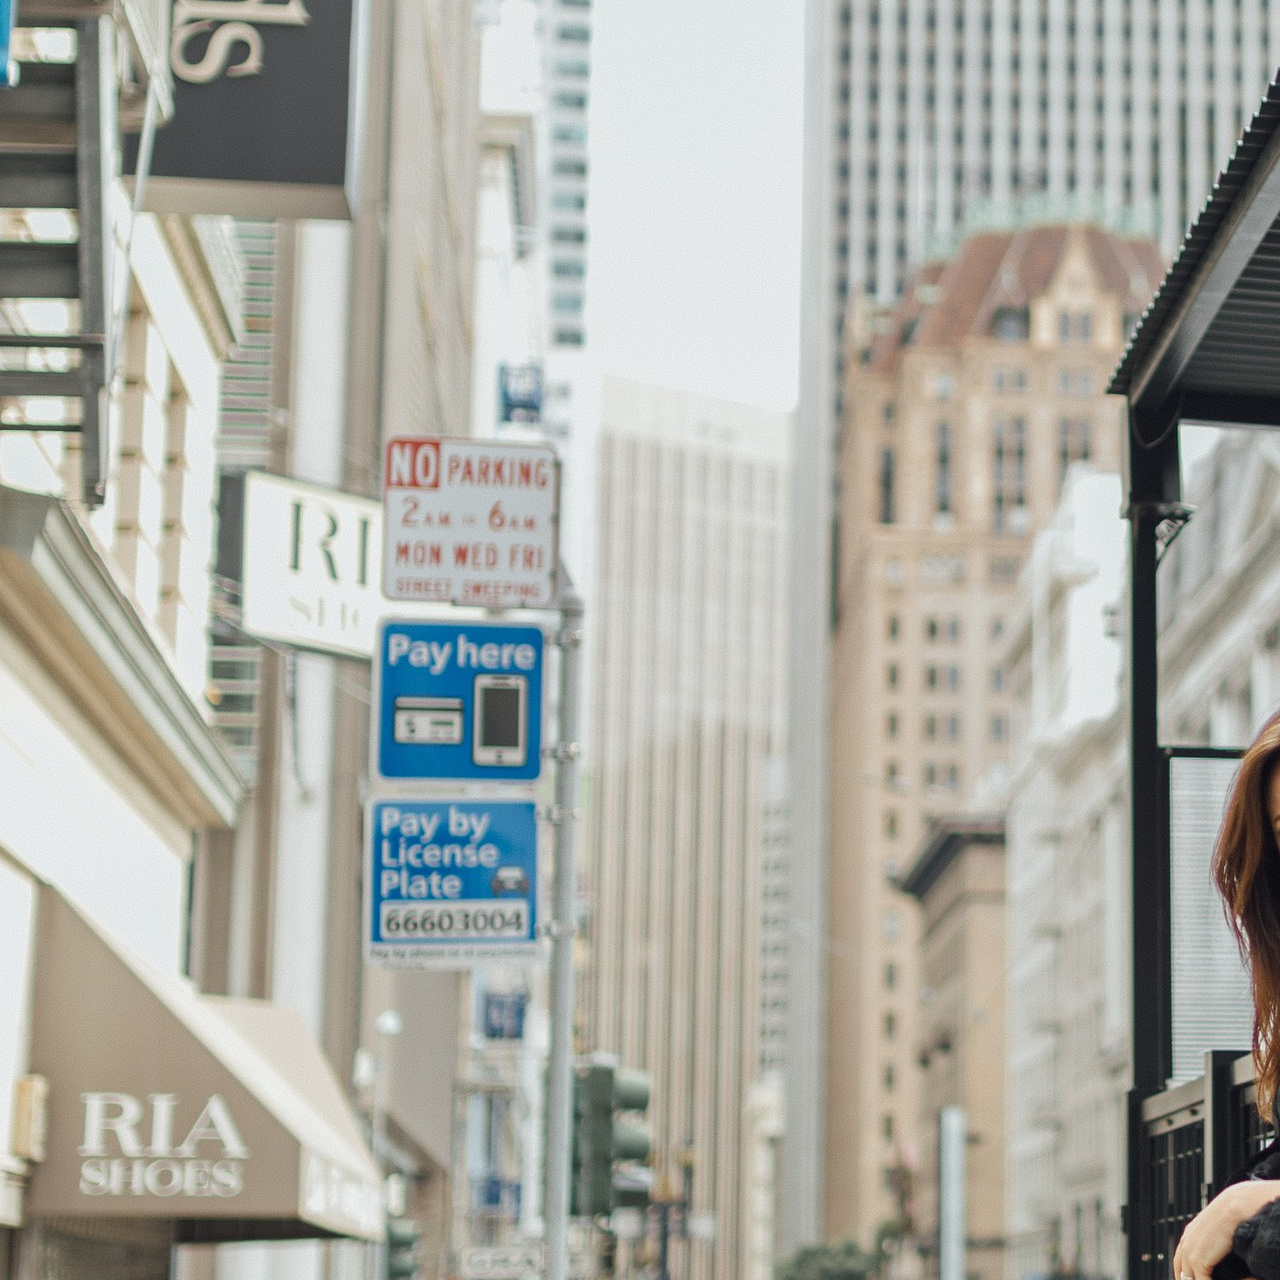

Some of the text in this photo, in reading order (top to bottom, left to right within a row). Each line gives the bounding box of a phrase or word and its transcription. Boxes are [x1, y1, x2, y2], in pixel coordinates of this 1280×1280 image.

[390, 443, 548, 490] NO PARKING
[288, 497, 370, 588] RI
[396, 540, 544, 572] MON WED FRI
[395, 577, 452, 595] STREET
[387, 632, 537, 676] Pay here
[380, 804, 491, 844] Pay by
[381, 836, 500, 868] License
[380, 866, 463, 898] Plate
[385, 909, 523, 933] 66603004
[76, 1092, 250, 1160] RIA
[78, 1158, 245, 1198] SHOES
